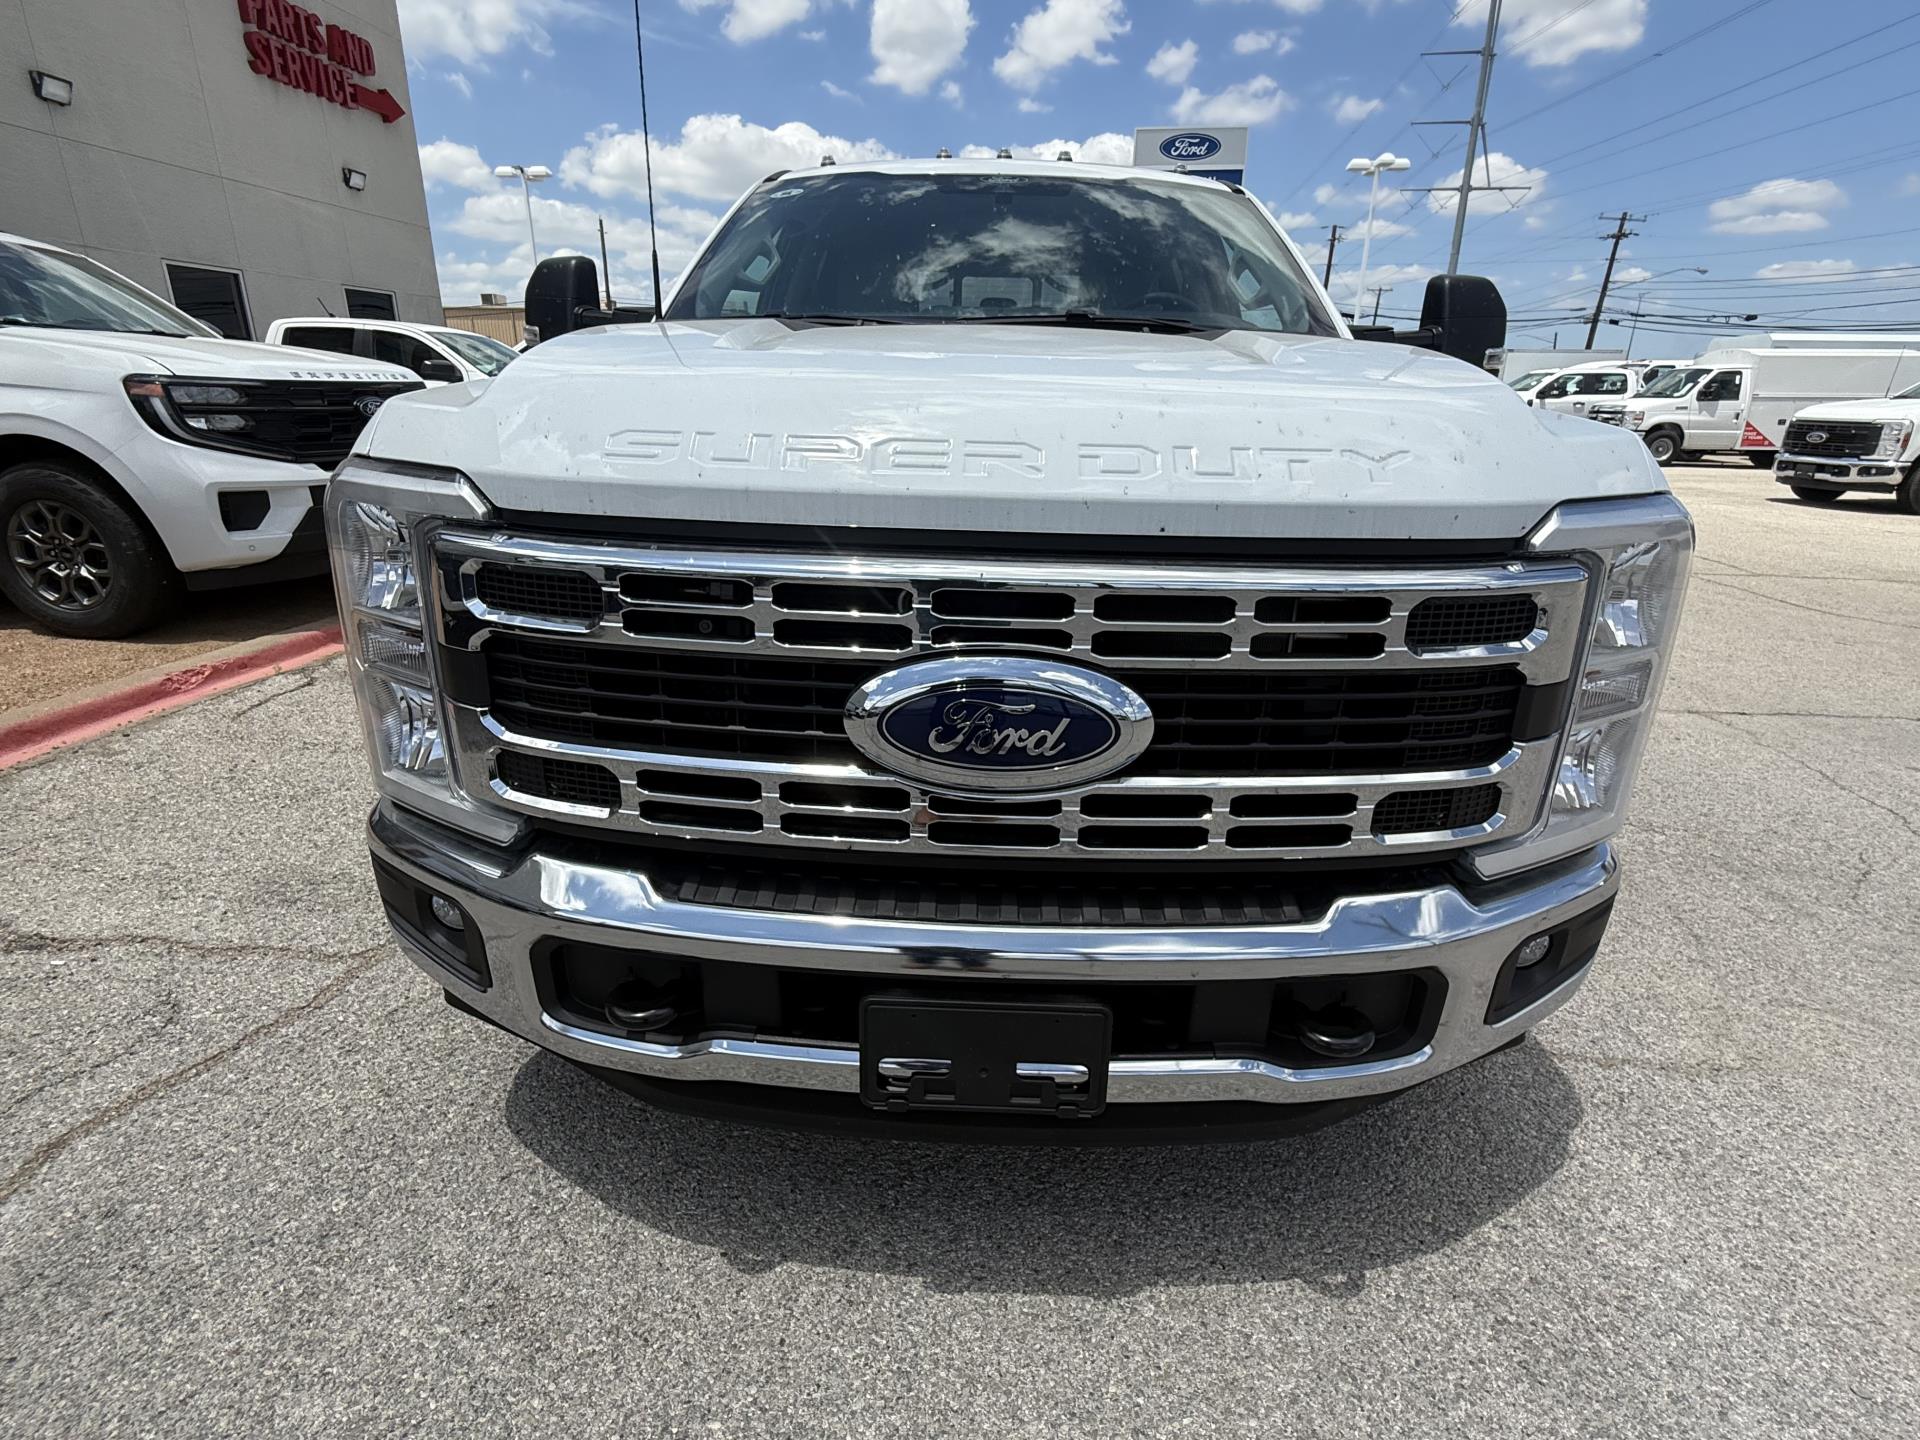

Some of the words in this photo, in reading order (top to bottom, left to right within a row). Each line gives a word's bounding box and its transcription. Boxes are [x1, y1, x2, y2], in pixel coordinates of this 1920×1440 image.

[243, 31, 359, 110] SERVICE
[326, 24, 376, 76] AND
[1170, 138, 1209, 156] Ford
[601, 428, 1045, 478] SUPER
[1078, 442, 1412, 484] DUTY
[928, 699, 1071, 757] Ford
